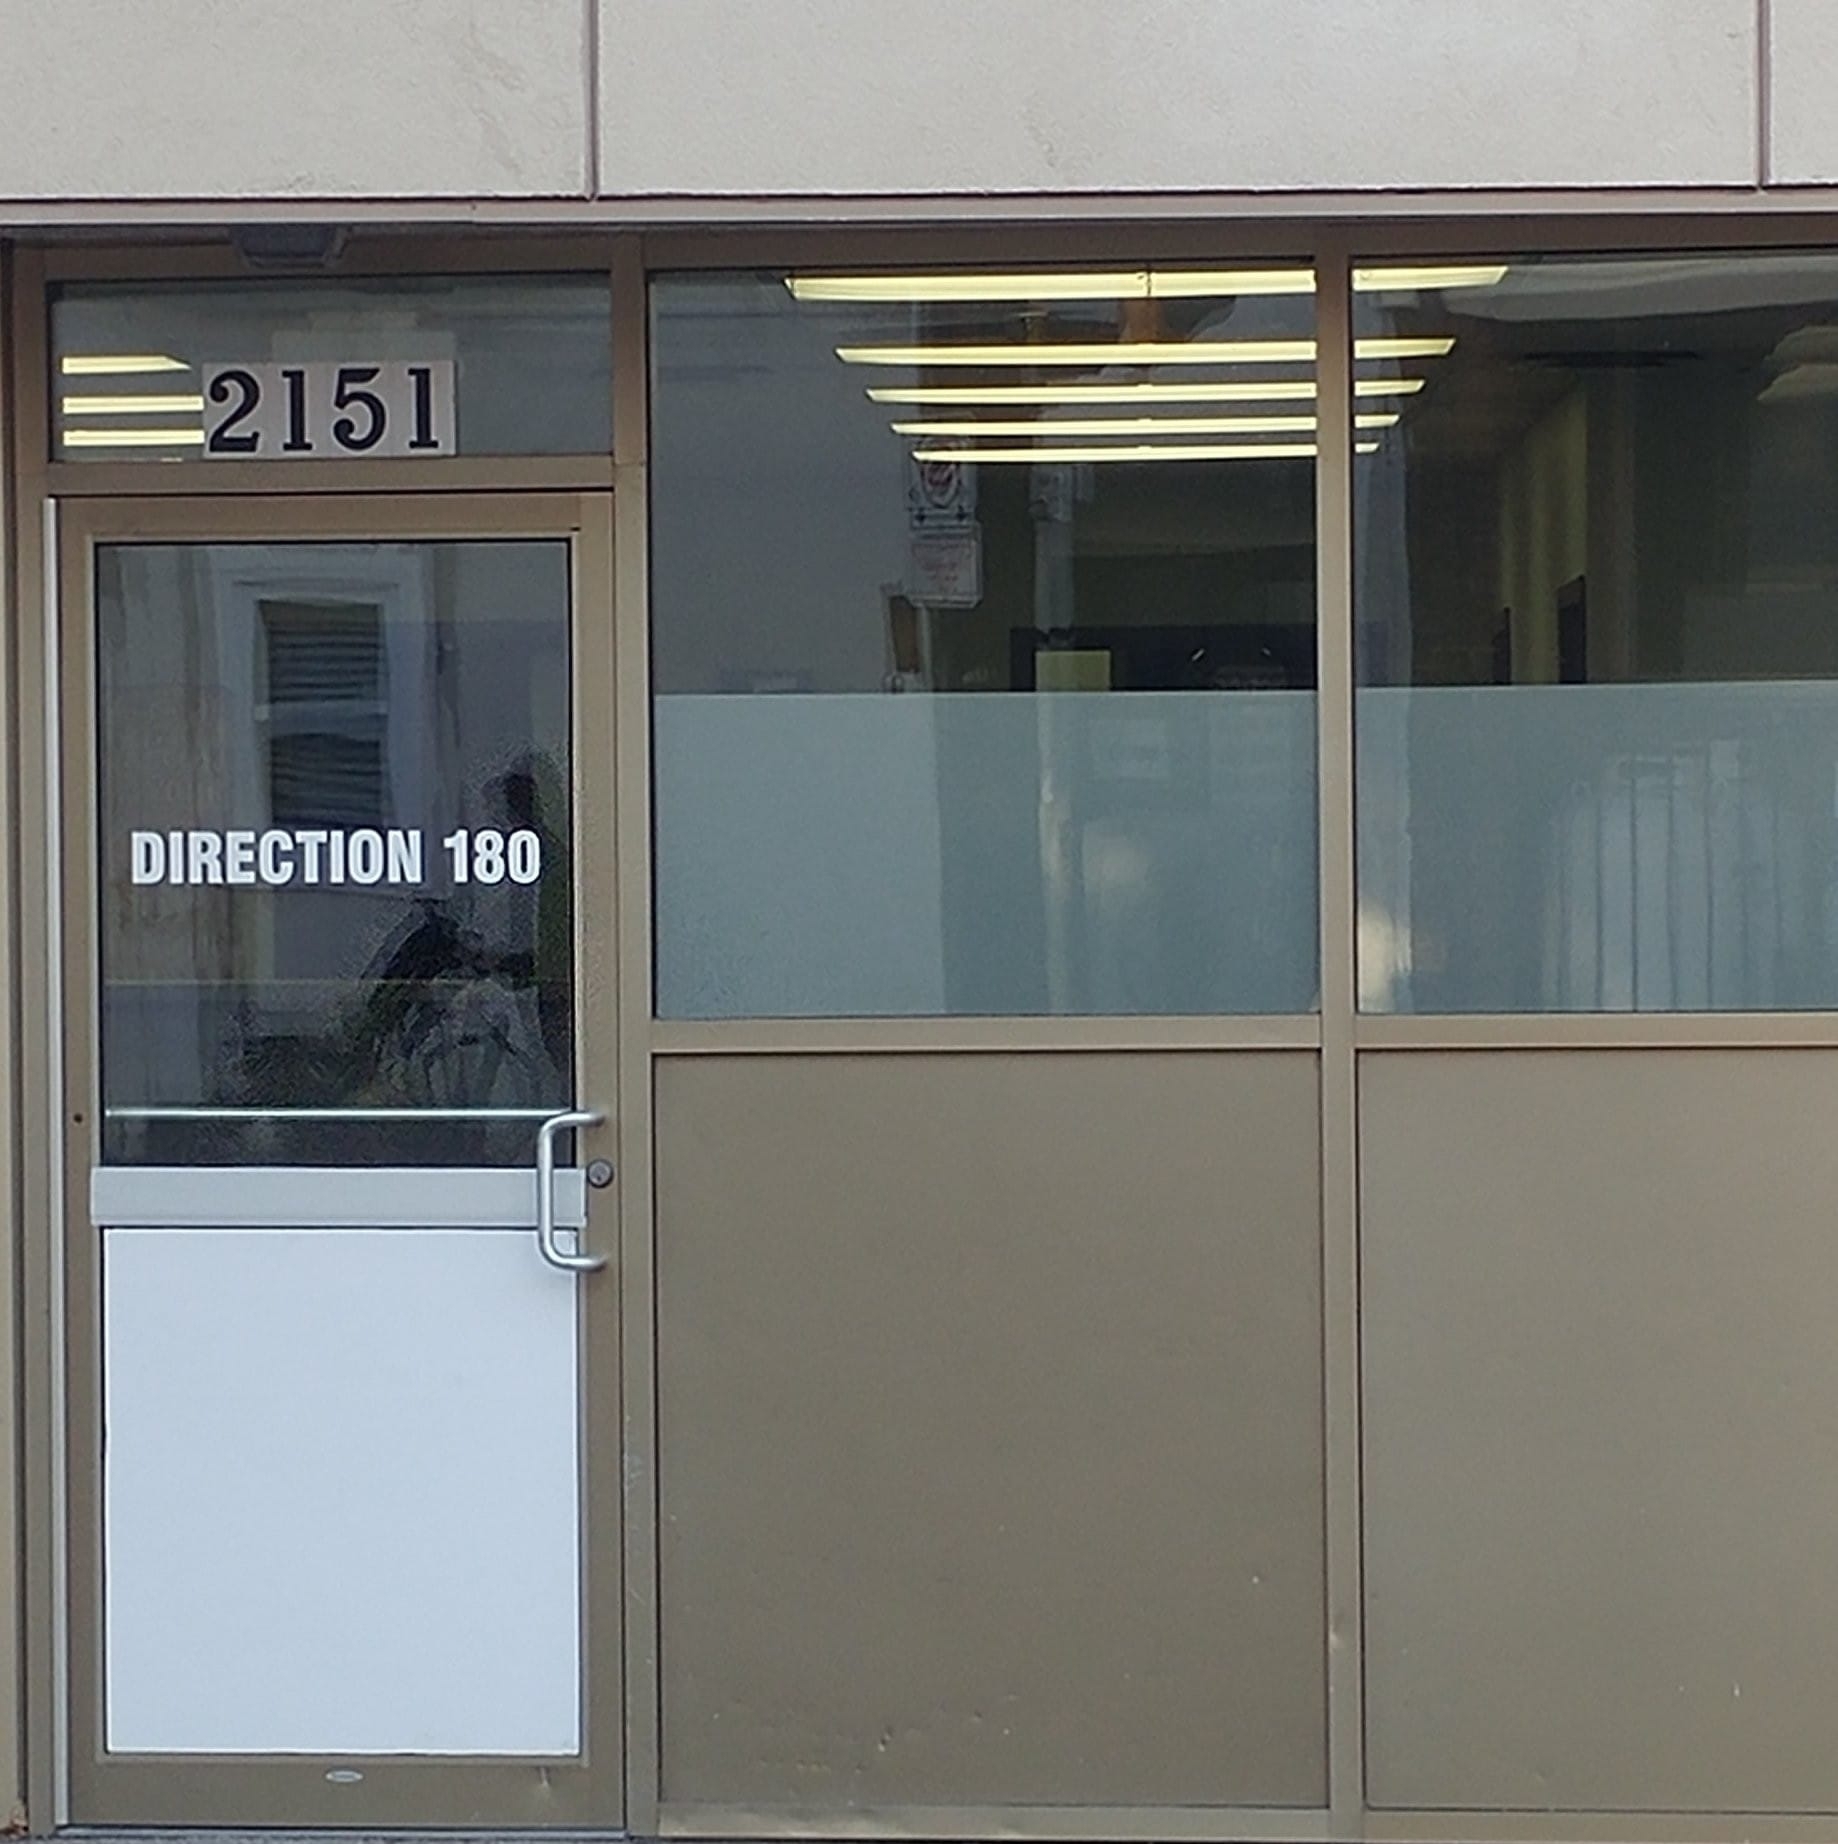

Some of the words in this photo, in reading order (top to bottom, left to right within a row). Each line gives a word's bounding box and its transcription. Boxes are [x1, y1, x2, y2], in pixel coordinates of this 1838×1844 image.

[208, 368, 440, 452] 2151
[131, 830, 423, 884] DIRECTION
[444, 829, 541, 884] 180
